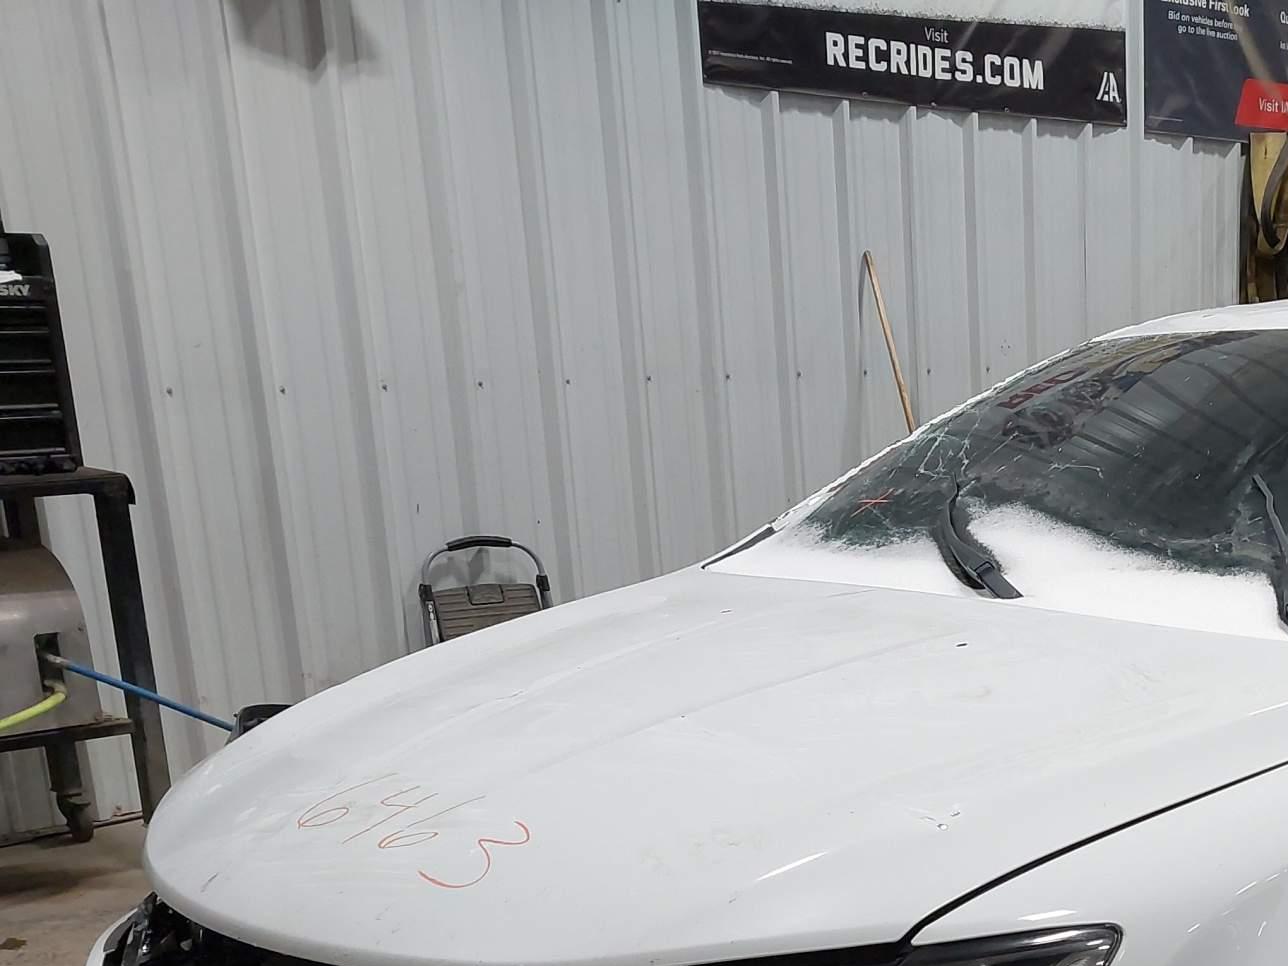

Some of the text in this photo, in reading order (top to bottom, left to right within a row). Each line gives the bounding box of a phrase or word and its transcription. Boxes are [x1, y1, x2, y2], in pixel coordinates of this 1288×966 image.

[1168, 10, 1180, 20] Bid
[1181, 14, 1190, 22] on
[1214, 18, 1233, 30] before
[924, 26, 949, 44] Visit
[1178, 25, 1187, 34] go
[1187, 25, 1195, 34] to
[1196, 25, 1206, 35] the
[1216, 30, 1238, 41] auction
[825, 31, 1045, 91] RECRIDES.COM
[1259, 97, 1279, 113] Visit
